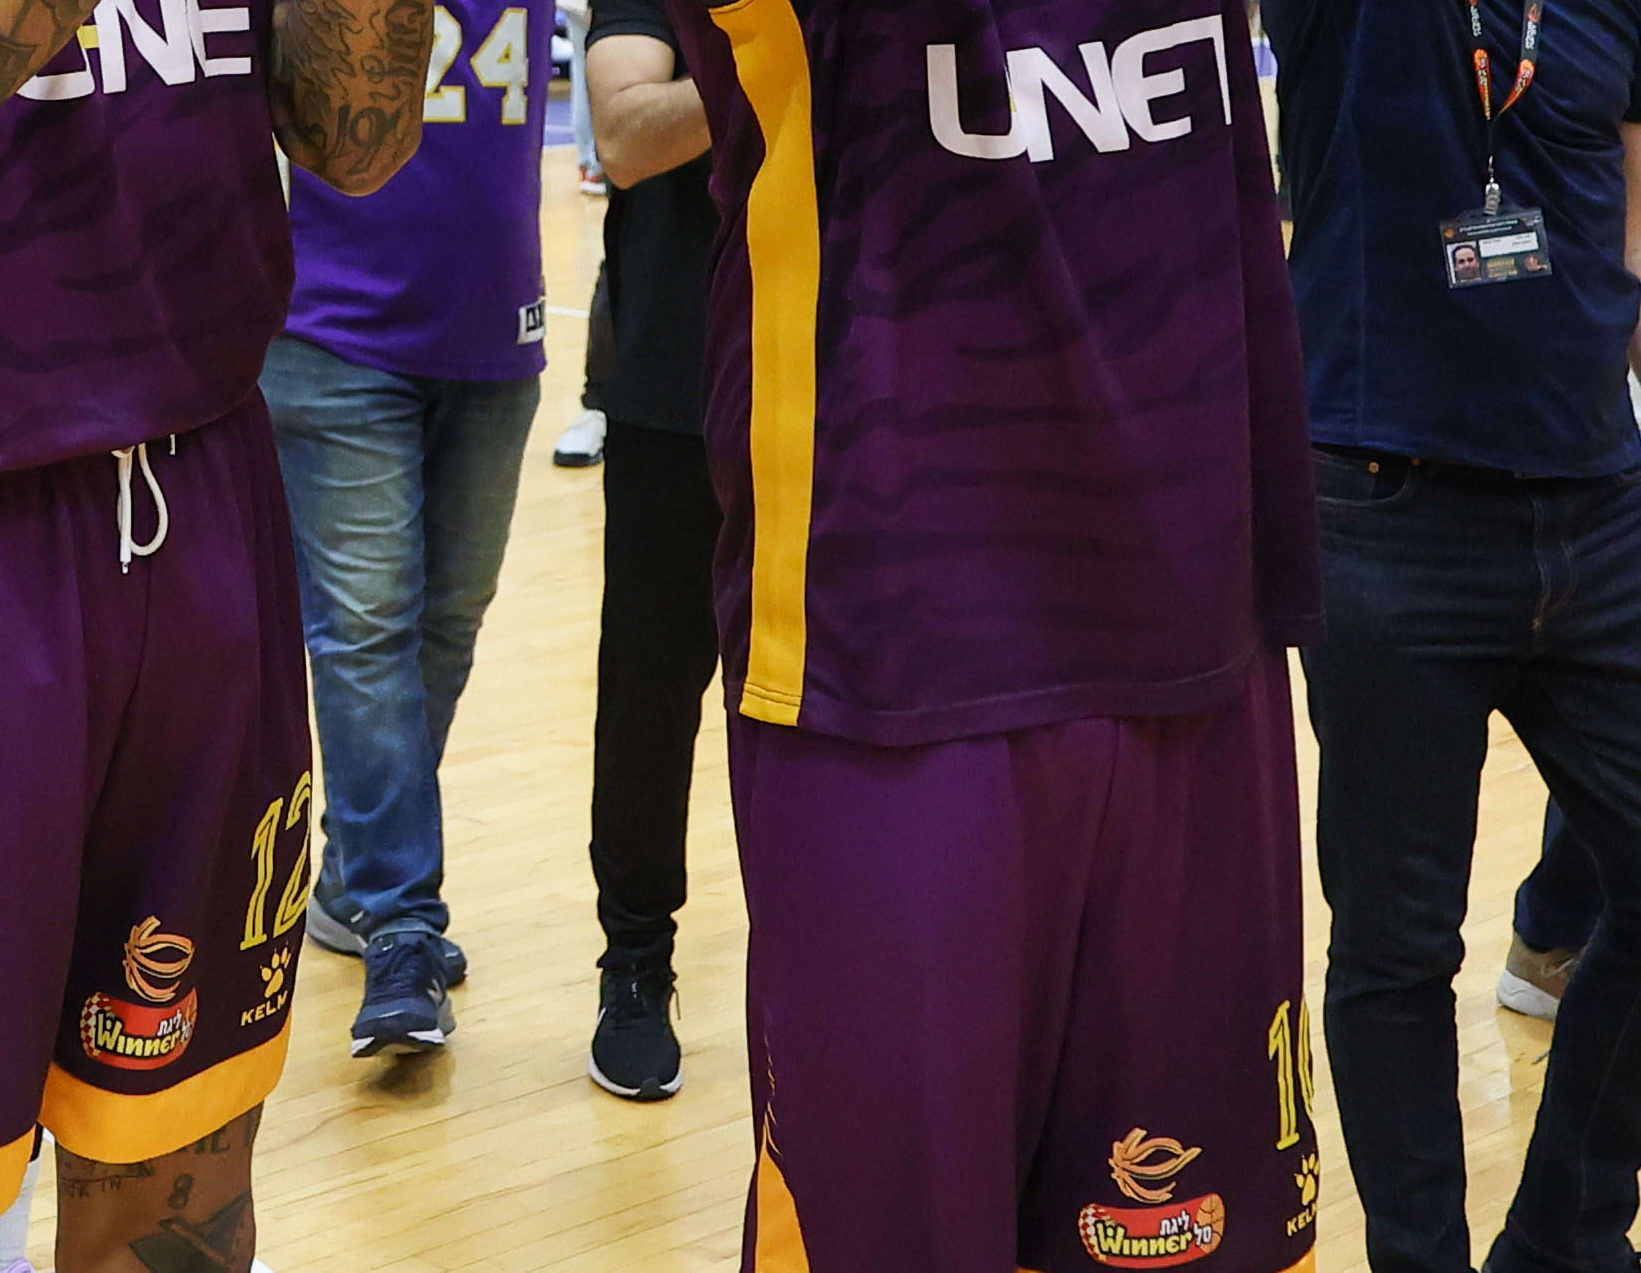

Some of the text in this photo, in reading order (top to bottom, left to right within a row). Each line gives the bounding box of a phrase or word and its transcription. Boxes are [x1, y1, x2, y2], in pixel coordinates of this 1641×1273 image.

[424, 4, 530, 125] 24
[239, 770, 311, 952] 12
[240, 991, 288, 1027] KELM
[96, 1011, 181, 1058] Winner
[1095, 1223, 1192, 1257] Winner
